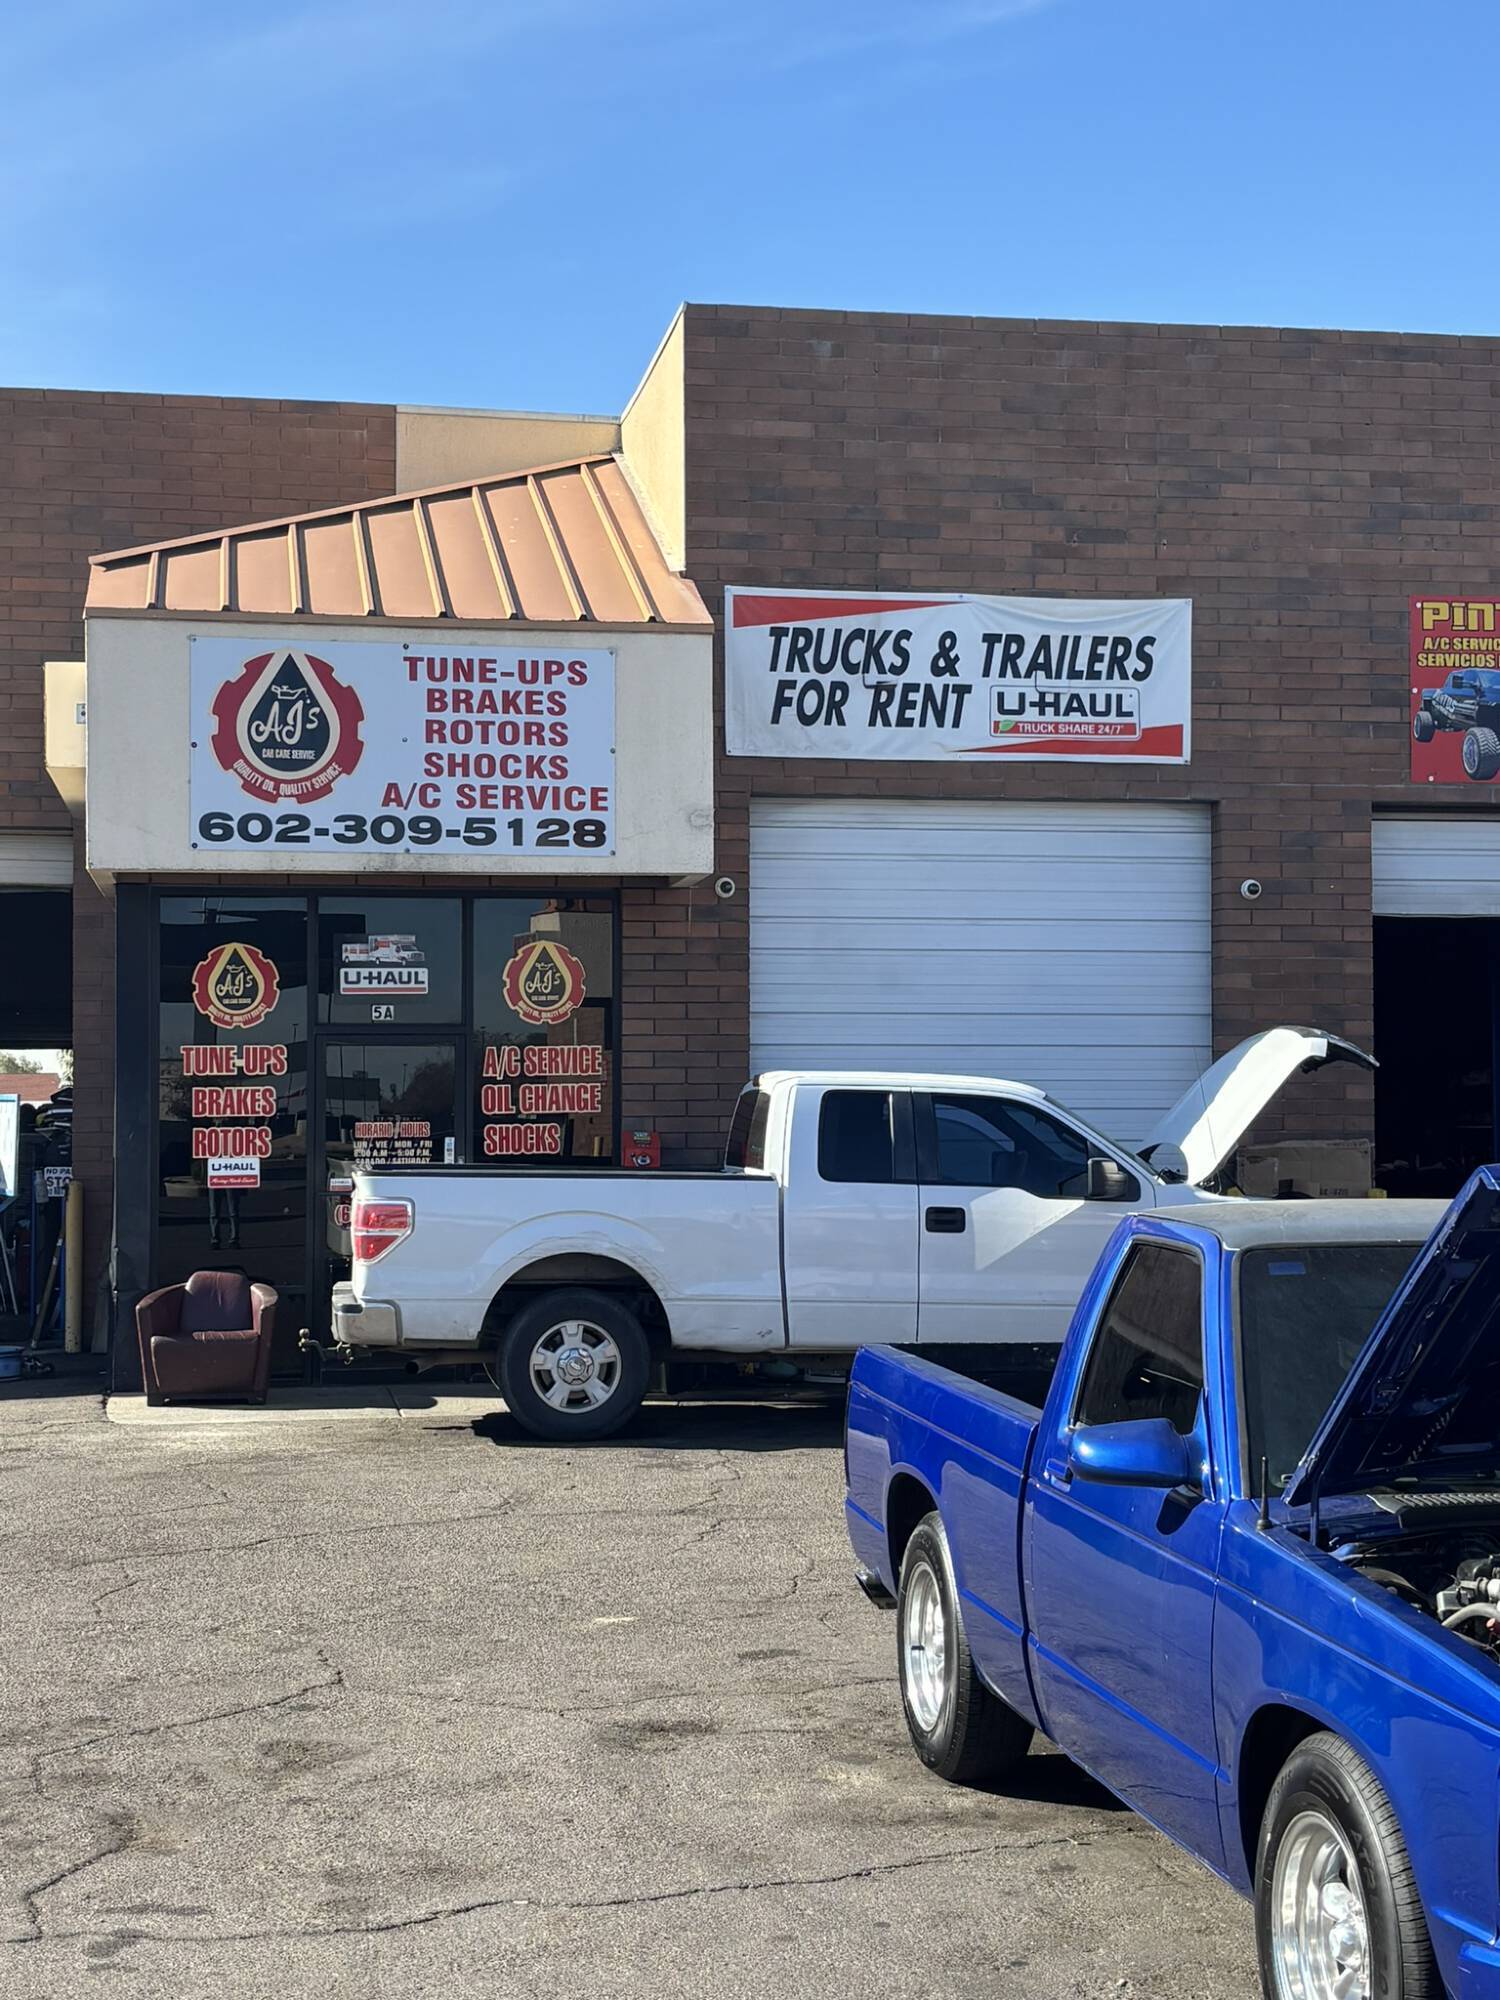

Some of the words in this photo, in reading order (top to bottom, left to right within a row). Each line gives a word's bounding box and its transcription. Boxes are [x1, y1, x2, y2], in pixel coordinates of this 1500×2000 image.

[768, 626, 913, 677] TRUCKS
[930, 630, 960, 677] &
[982, 633, 1156, 681] TRAILERS
[1424, 637, 1450, 650] A/C
[403, 656, 588, 686] TUNE-UPS
[1417, 653, 1495, 667] SERVICIOS
[426, 688, 567, 716] BRAKES
[770, 679, 850, 727] FOR
[868, 682, 972, 729] RENT
[997, 691, 1134, 717] U-HAUL
[424, 719, 569, 747] ROTORS
[1017, 723, 1056, 734] TRUCK
[1058, 723, 1096, 734] SHARE
[1098, 724, 1121, 735] 24/7
[262, 748, 274, 759] CAR
[275, 748, 291, 759] CARE
[291, 749, 316, 760] SERVICE
[423, 752, 569, 780] SHOCKS
[233, 759, 264, 786] QUALITY
[279, 781, 313, 796] QUALITY
[313, 762, 343, 789] SERVICE
[381, 782, 441, 810] A/C
[456, 783, 609, 811] SERVICE
[198, 811, 607, 848] 602-309-5128
[344, 971, 425, 985] U-HAUL
[373, 1006, 393, 1019] 5A
[181, 1045, 287, 1076] TUNE-UPS
[483, 1046, 520, 1080] A/C
[524, 1045, 602, 1076] SERVICE
[192, 1086, 276, 1117] BRAKES
[481, 1085, 515, 1114] OIL
[519, 1083, 601, 1113] CHANGE
[192, 1127, 272, 1158] ROTORS
[355, 1122, 394, 1138] HORARIO
[400, 1122, 430, 1138] HOURS
[484, 1123, 561, 1155] SHOCKS
[353, 1140, 368, 1149] LUN
[212, 1163, 256, 1171] U-HAUL
